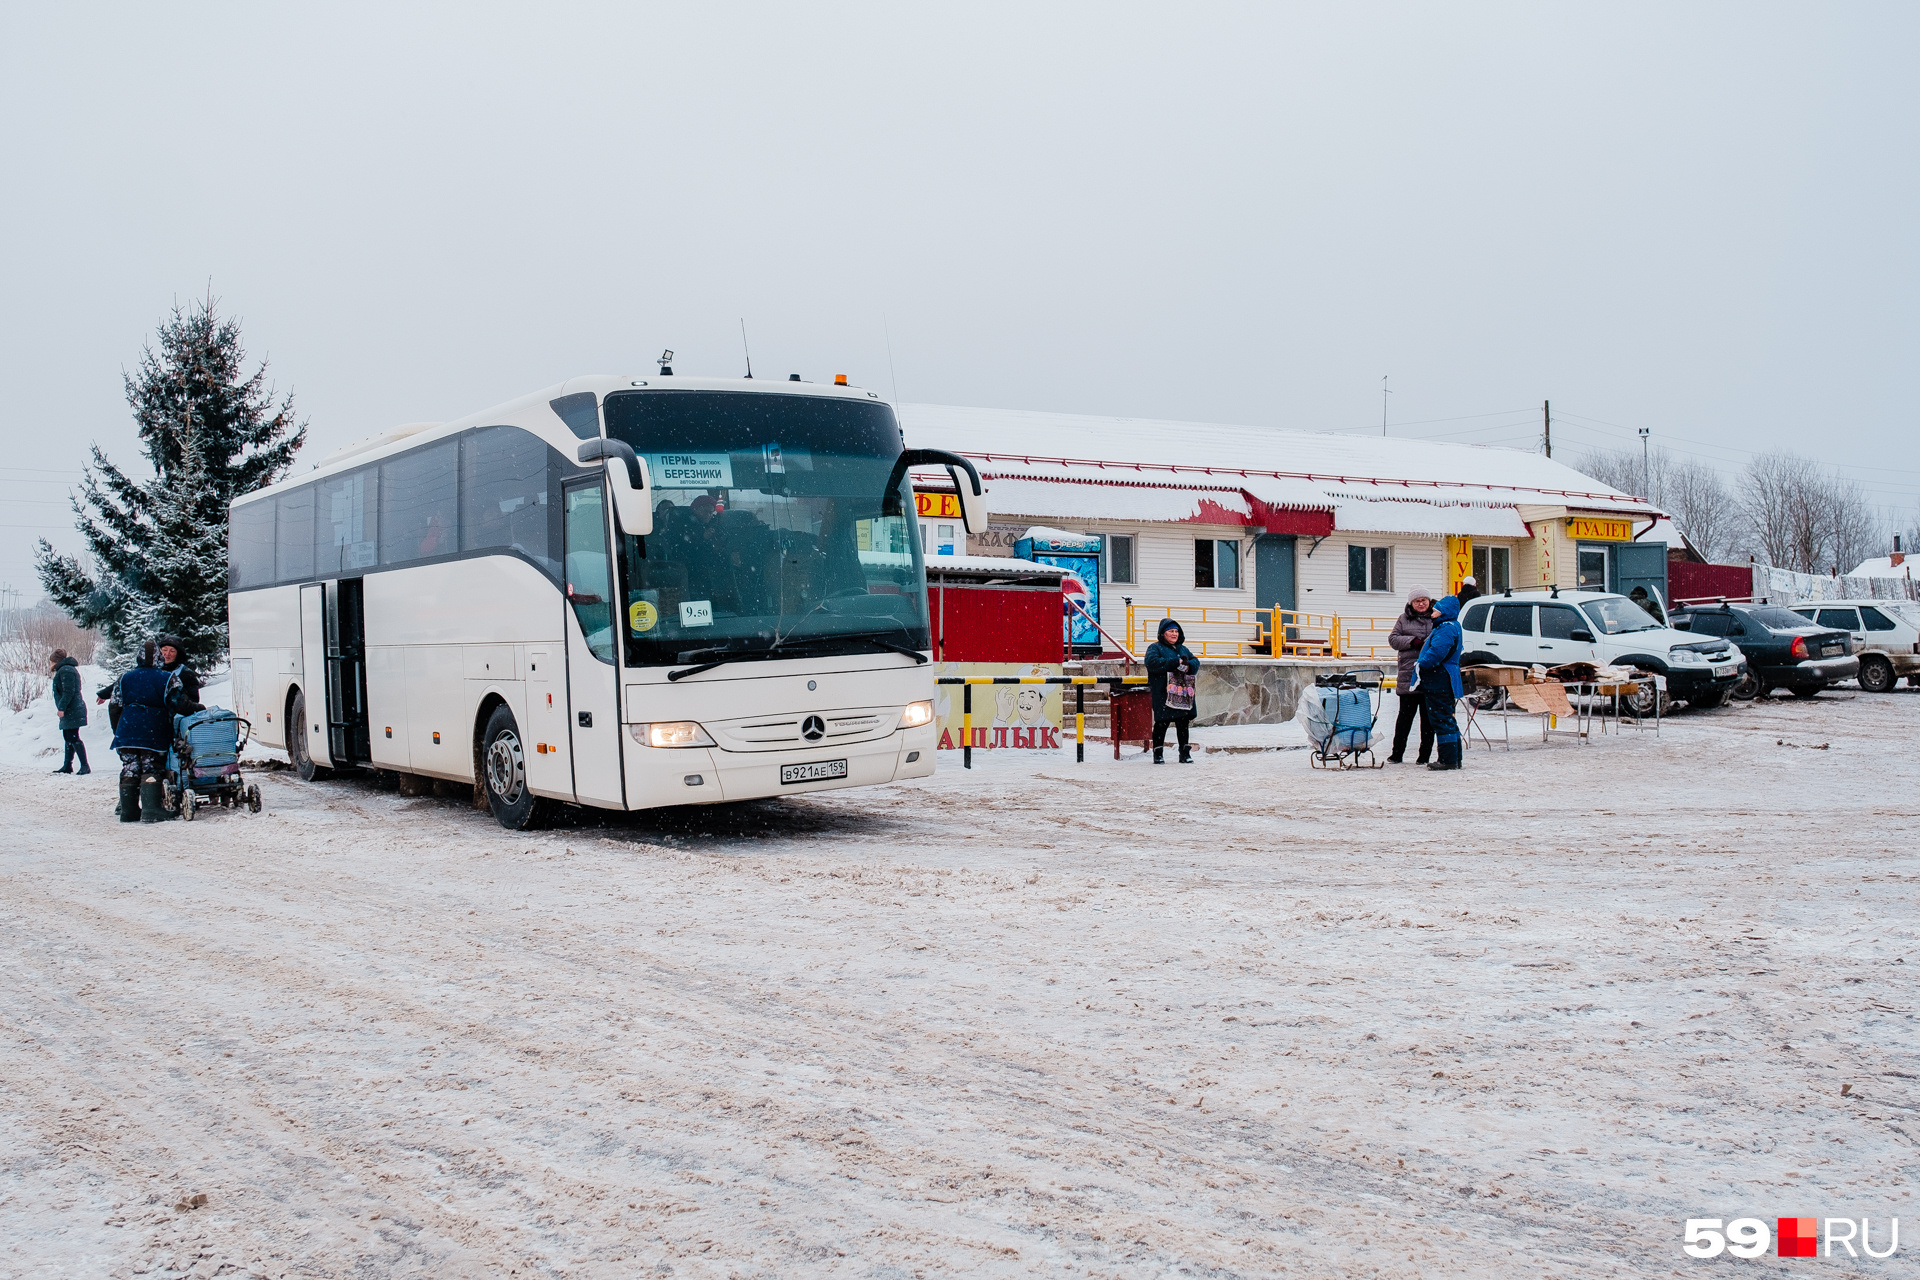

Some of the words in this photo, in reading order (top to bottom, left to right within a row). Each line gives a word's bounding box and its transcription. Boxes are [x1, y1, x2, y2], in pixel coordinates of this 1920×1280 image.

[661, 455, 697, 465] ПЕРМЬ
[664, 469, 722, 479] БЕРЕЗНИКИ
[915, 493, 955, 516] ФЕ
[1574, 521, 1629, 538] ТУАЛЕТ
[978, 532, 1025, 548] КАФ
[1061, 541, 1085, 549] PEPSI
[686, 606, 708, 618] 9.50
[937, 727, 1059, 750] АШЛЫК
[829, 761, 844, 772] 159
